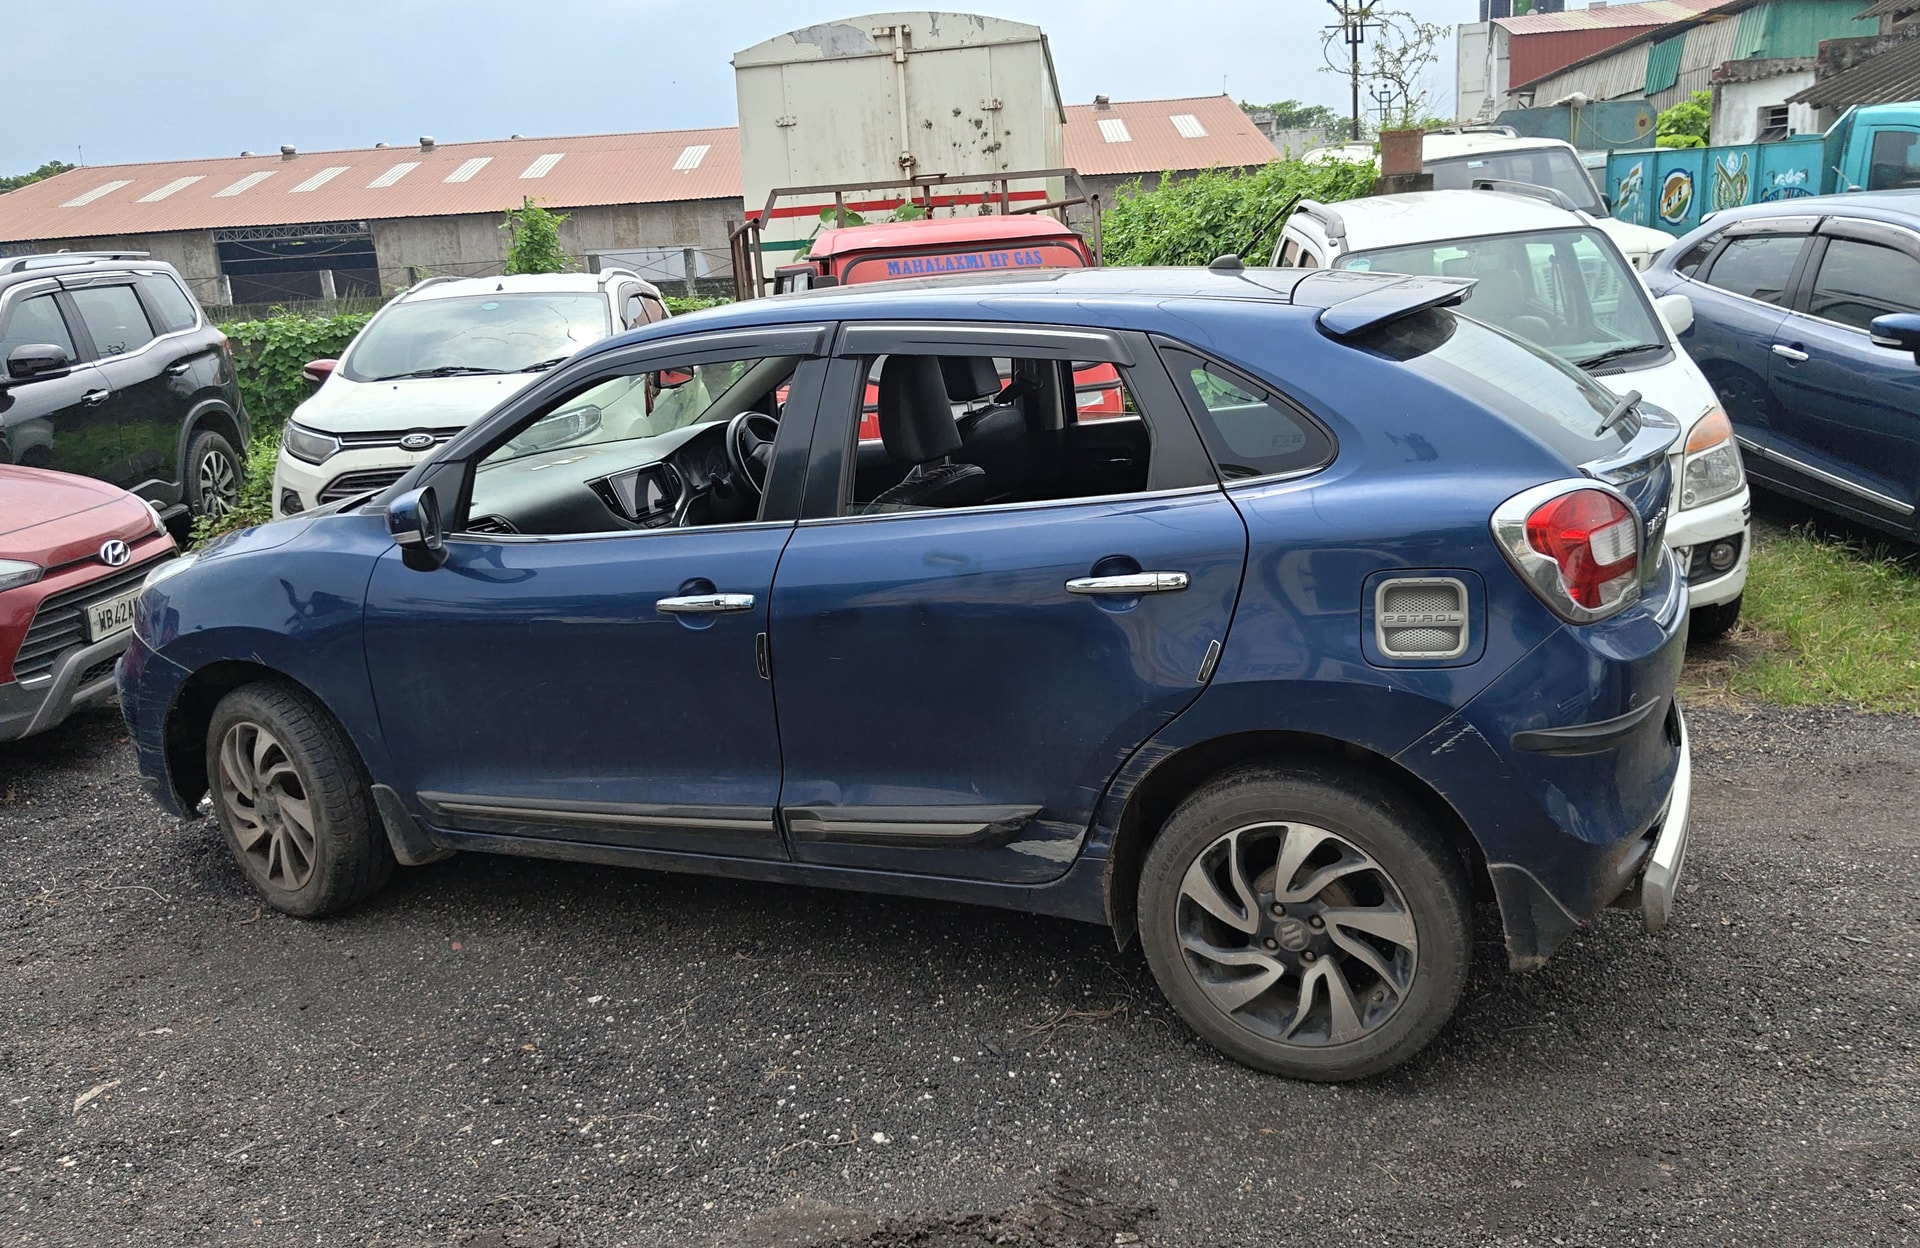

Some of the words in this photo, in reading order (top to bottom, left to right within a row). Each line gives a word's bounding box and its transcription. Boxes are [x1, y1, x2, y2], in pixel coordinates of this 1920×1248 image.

[886, 254, 986, 276] MAHALAXMI
[989, 252, 1009, 268] HP
[1013, 250, 1043, 266] GAS
[1383, 613, 1460, 623] PETROL
